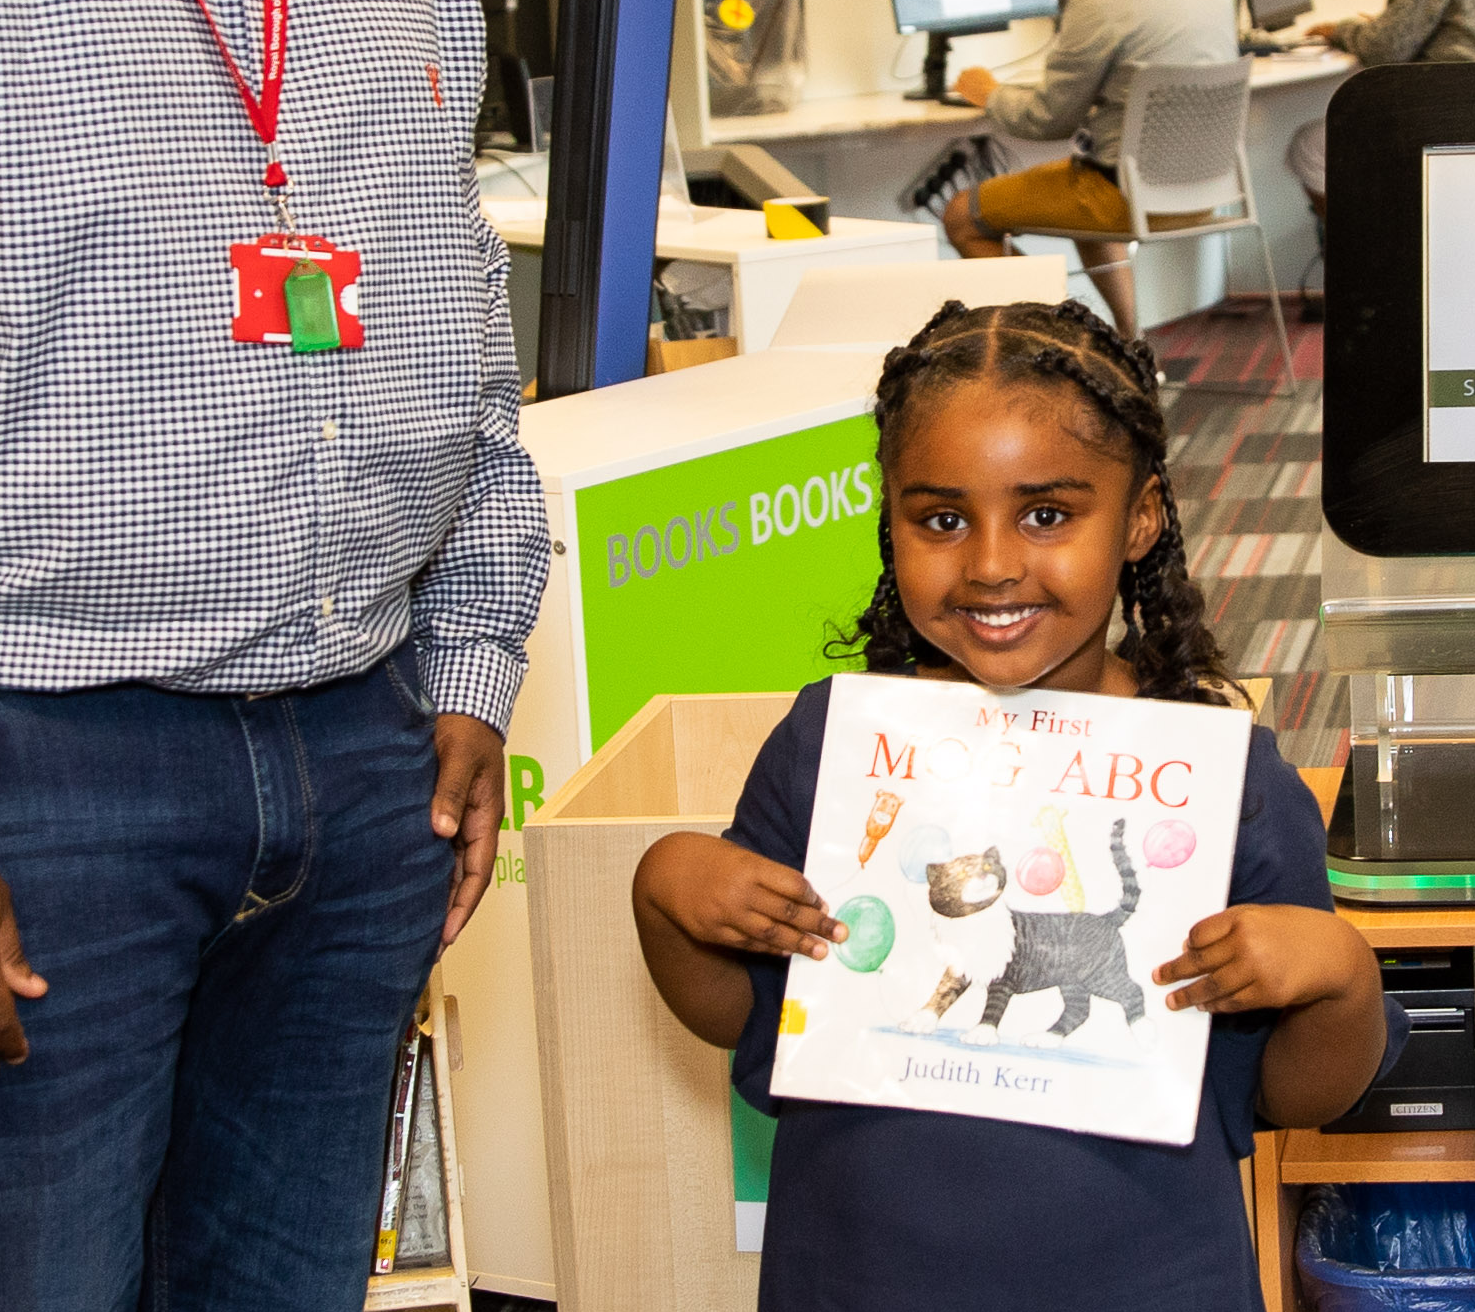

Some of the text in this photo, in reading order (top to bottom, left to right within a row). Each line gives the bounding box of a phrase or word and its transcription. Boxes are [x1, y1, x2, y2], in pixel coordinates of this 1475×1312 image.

[607, 463, 874, 588] BOOKS BOOKS
[975, 707, 1093, 737] My First
[865, 733, 1193, 807] MOG ABC
[899, 1057, 1054, 1093] Judith Kerr
[1396, 1104, 1438, 1115] CITIZEN
